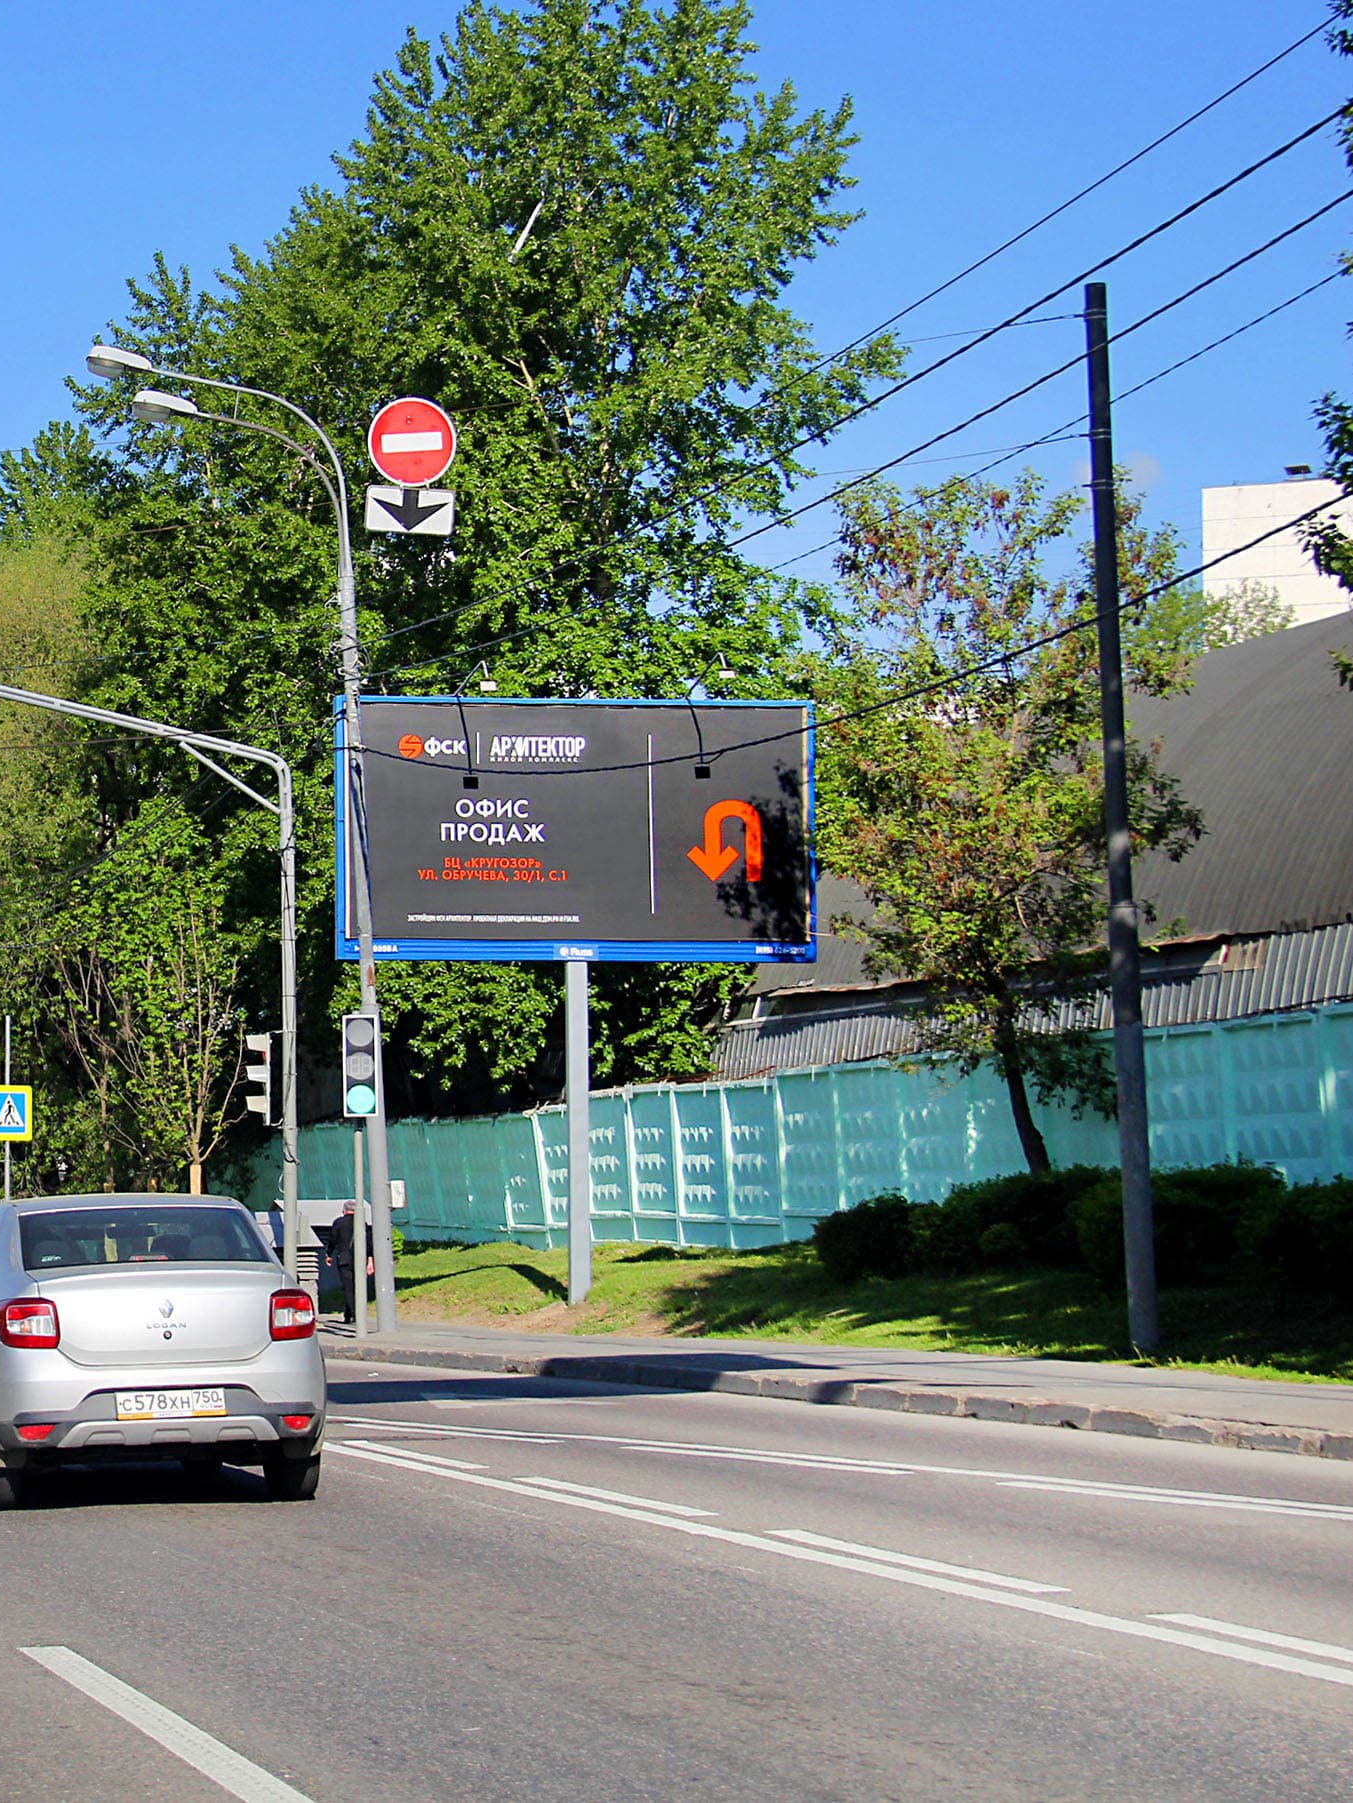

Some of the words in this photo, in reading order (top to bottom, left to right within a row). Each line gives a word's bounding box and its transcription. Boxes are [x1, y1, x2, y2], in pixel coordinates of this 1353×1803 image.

[489, 736, 586, 757] АРХИТЕКТОР
[455, 798, 529, 819] ОФИС
[440, 823, 545, 846] ПРОДАЖ
[444, 858, 461, 870] БЦ
[465, 858, 542, 869] «КРУГОЗОР»
[418, 870, 437, 881] УЛ.
[442, 870, 509, 882] ОБРУЧЕВА,
[513, 870, 545, 883] 30/1,
[146, 1322, 187, 1330] LOGAN
[193, 1390, 219, 1404] 750
